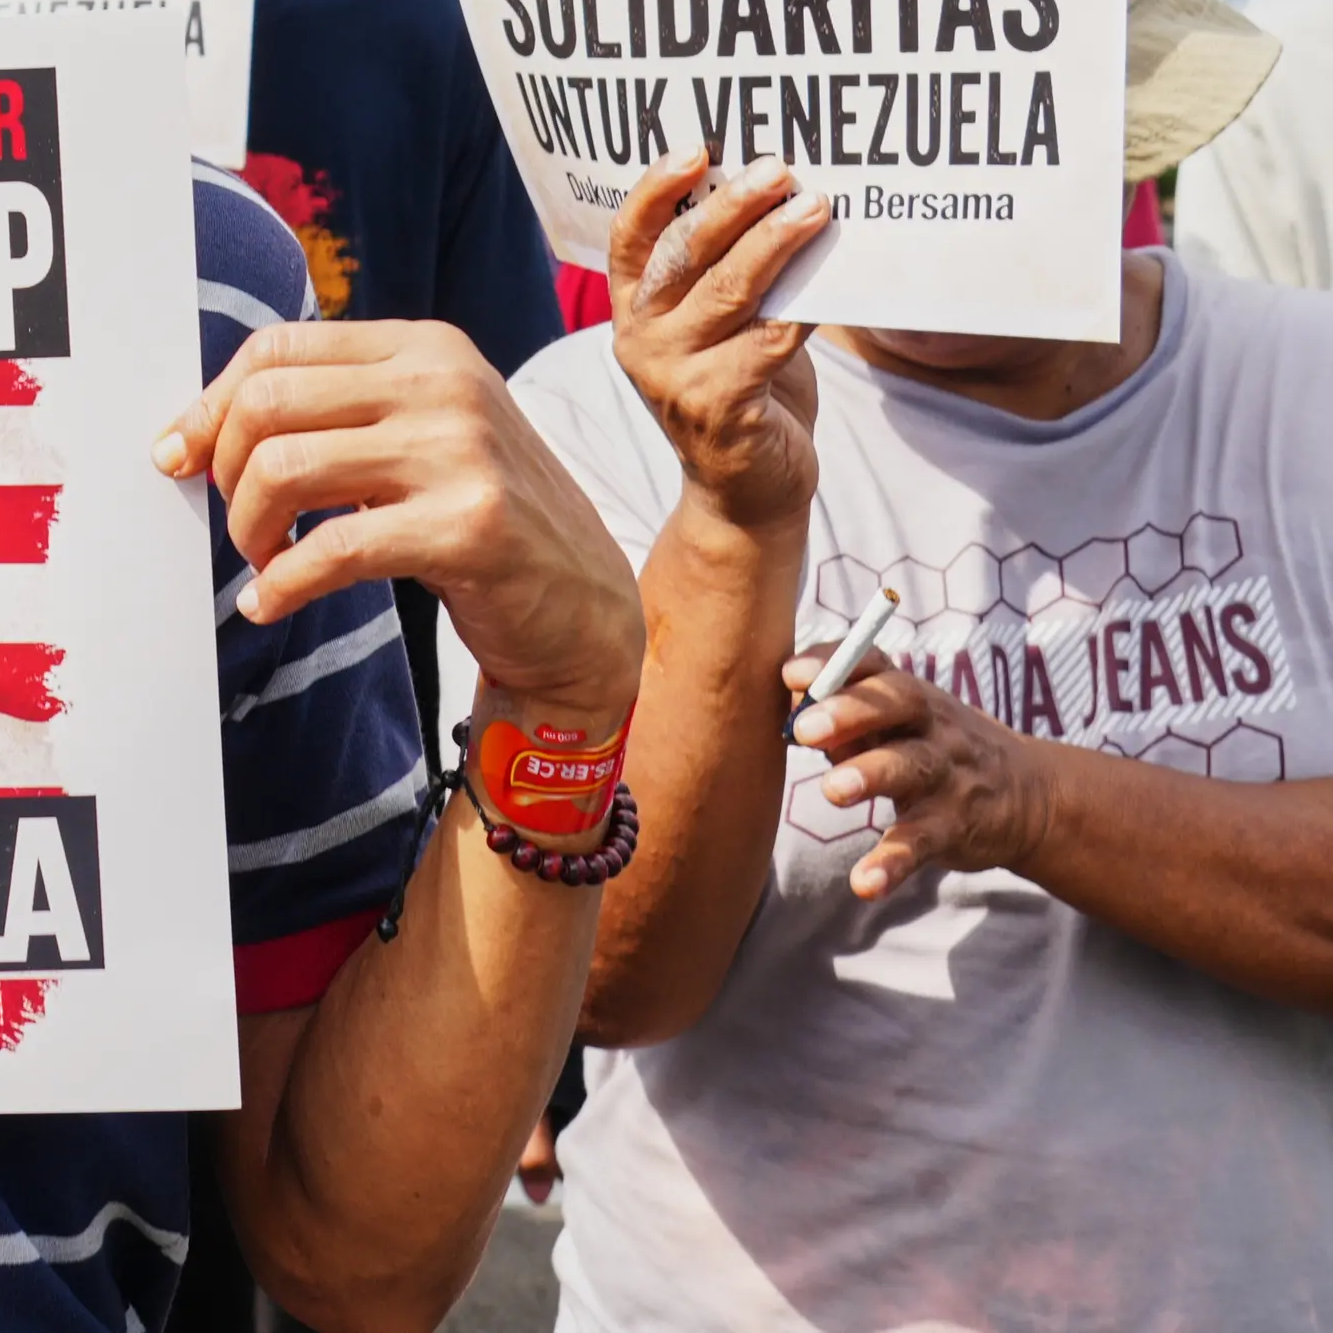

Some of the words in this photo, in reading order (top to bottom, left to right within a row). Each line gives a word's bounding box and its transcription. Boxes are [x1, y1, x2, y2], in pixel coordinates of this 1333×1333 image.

[516, 73, 669, 165] UNTUK
[693, 71, 1061, 167] VENEZUELA
[864, 185, 1015, 220] Bersama
[1082, 602, 1273, 729] JEANS
